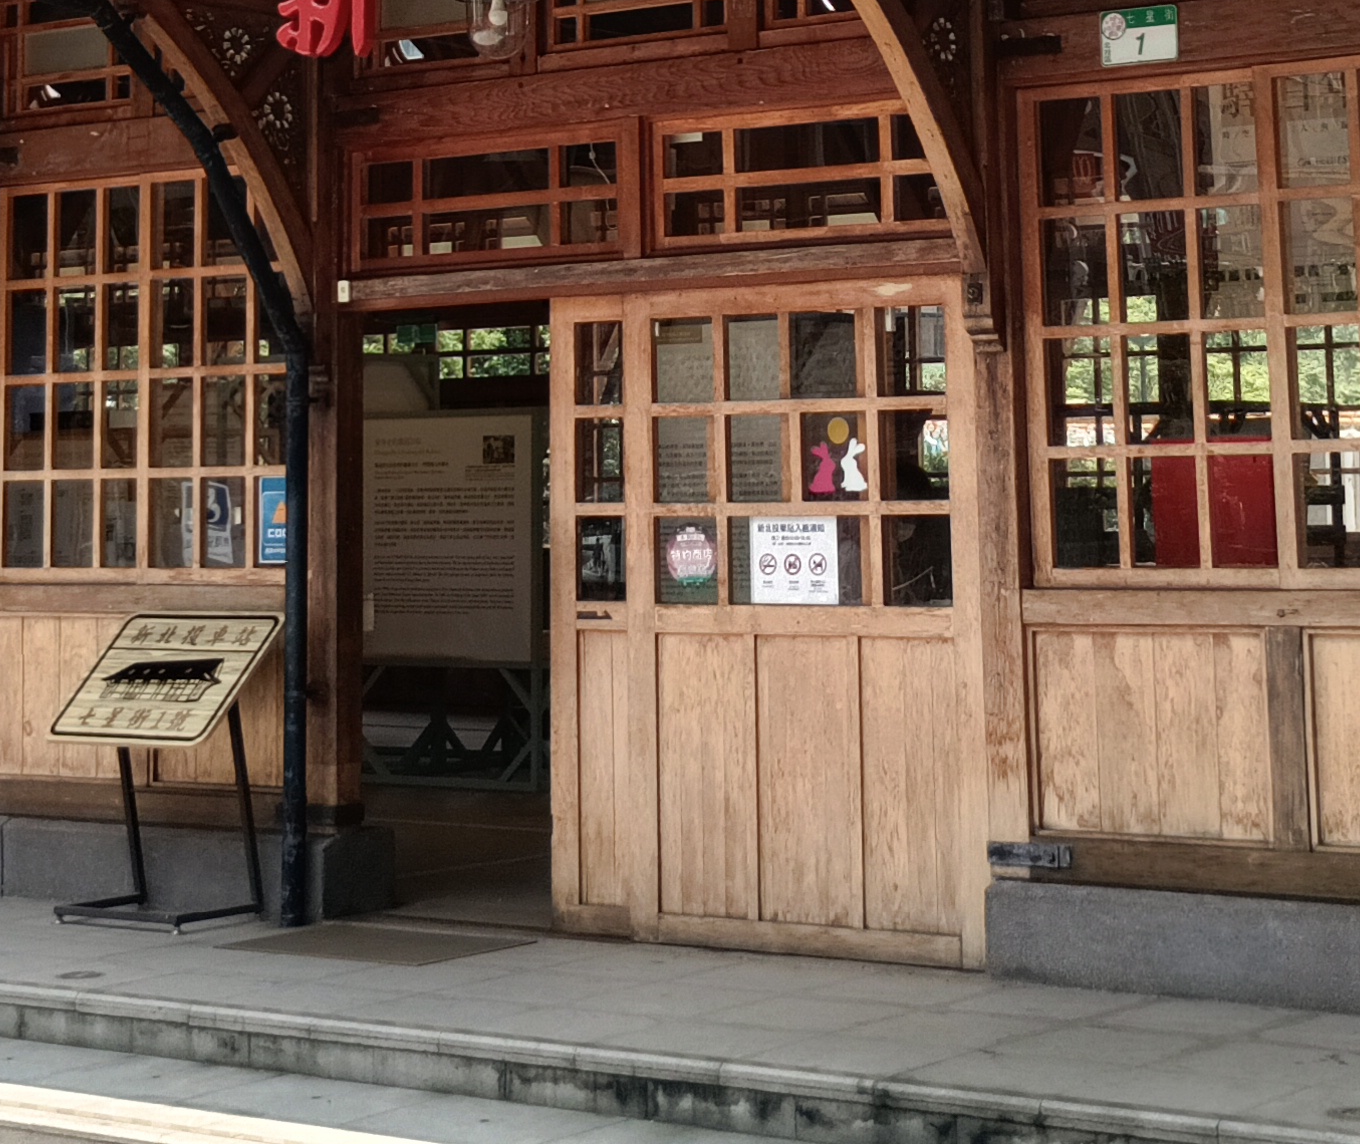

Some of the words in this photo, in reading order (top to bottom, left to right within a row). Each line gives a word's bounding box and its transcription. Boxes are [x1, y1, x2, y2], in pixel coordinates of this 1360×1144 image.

[1126, 8, 1174, 24] 七星街
[1135, 32, 1146, 56] 1
[130, 624, 257, 646] 新北投車站
[78, 707, 191, 732] 七星街1號
